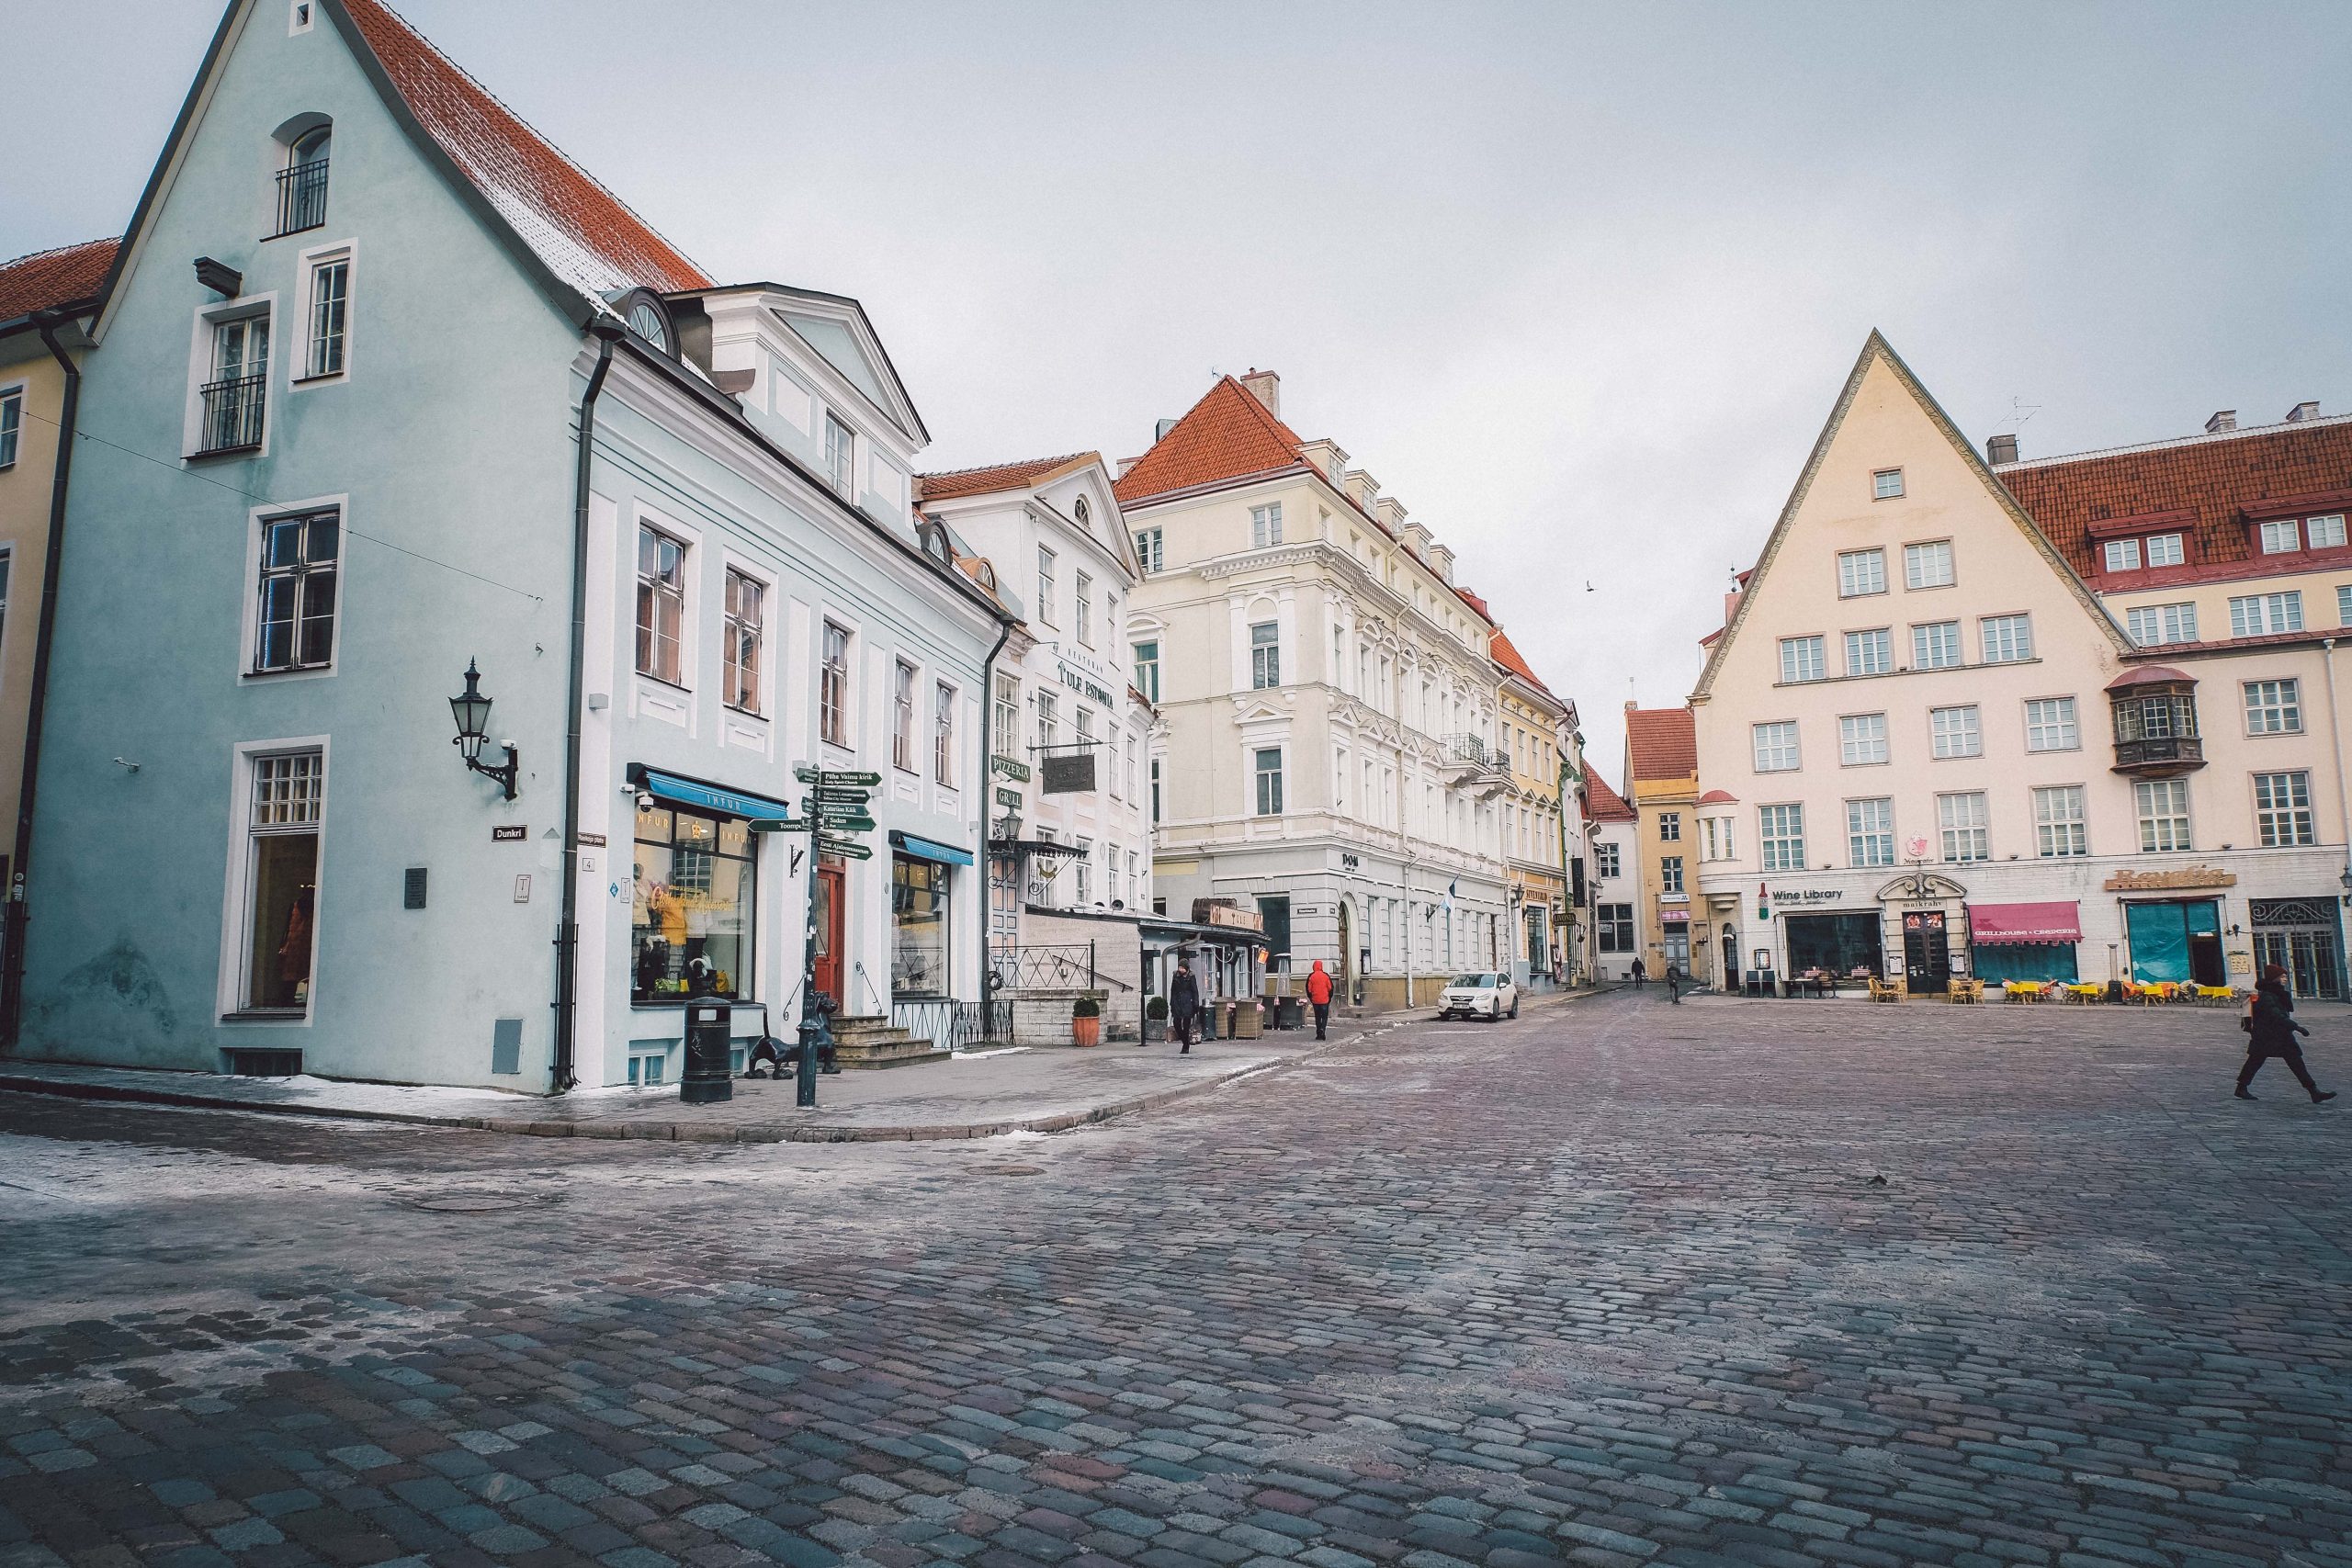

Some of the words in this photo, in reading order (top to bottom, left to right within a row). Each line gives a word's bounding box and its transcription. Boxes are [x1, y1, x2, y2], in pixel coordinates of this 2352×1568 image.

[1085, 681, 1114, 710] ESTONIA
[993, 758, 1029, 779] PIZZERIA
[707, 794, 741, 811] INFUR
[999, 791, 1021, 807] GRILL
[497, 829, 521, 838] Dunkri
[586, 861, 591, 869] 4
[1772, 891, 1801, 900] Wine
[1804, 889, 1843, 900] Library
